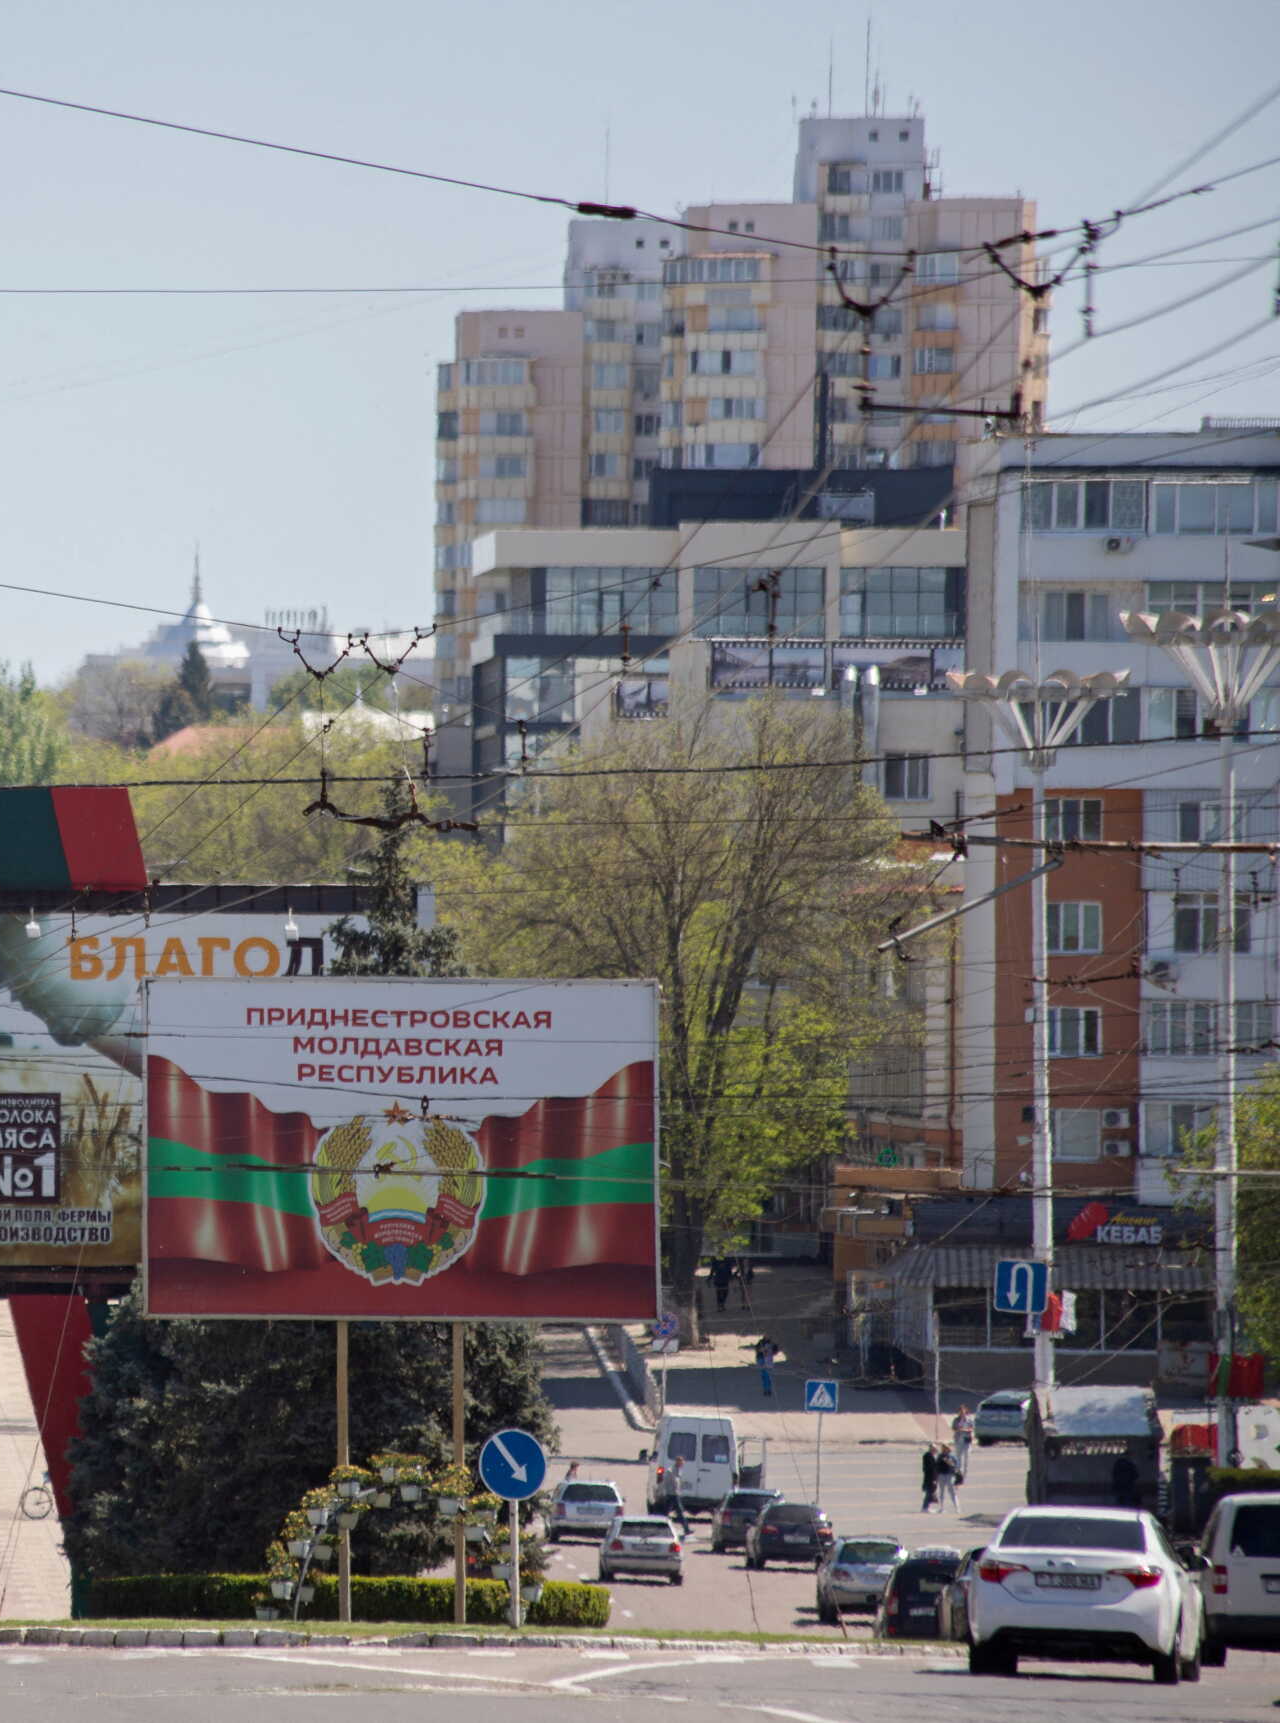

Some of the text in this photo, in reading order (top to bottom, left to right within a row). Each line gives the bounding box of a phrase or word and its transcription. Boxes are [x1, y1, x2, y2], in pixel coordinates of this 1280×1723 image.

[246, 1007, 552, 1030] ПРИДНЕСТРОВСКАЯ
[292, 1036, 503, 1059] МОЛДАВСКАЯ
[297, 1063, 499, 1085] РЕСПУБЛИКА
[58, 1210, 112, 1223] ФЕРМЫ
[1096, 1225, 1163, 1244] КЕБАБ
